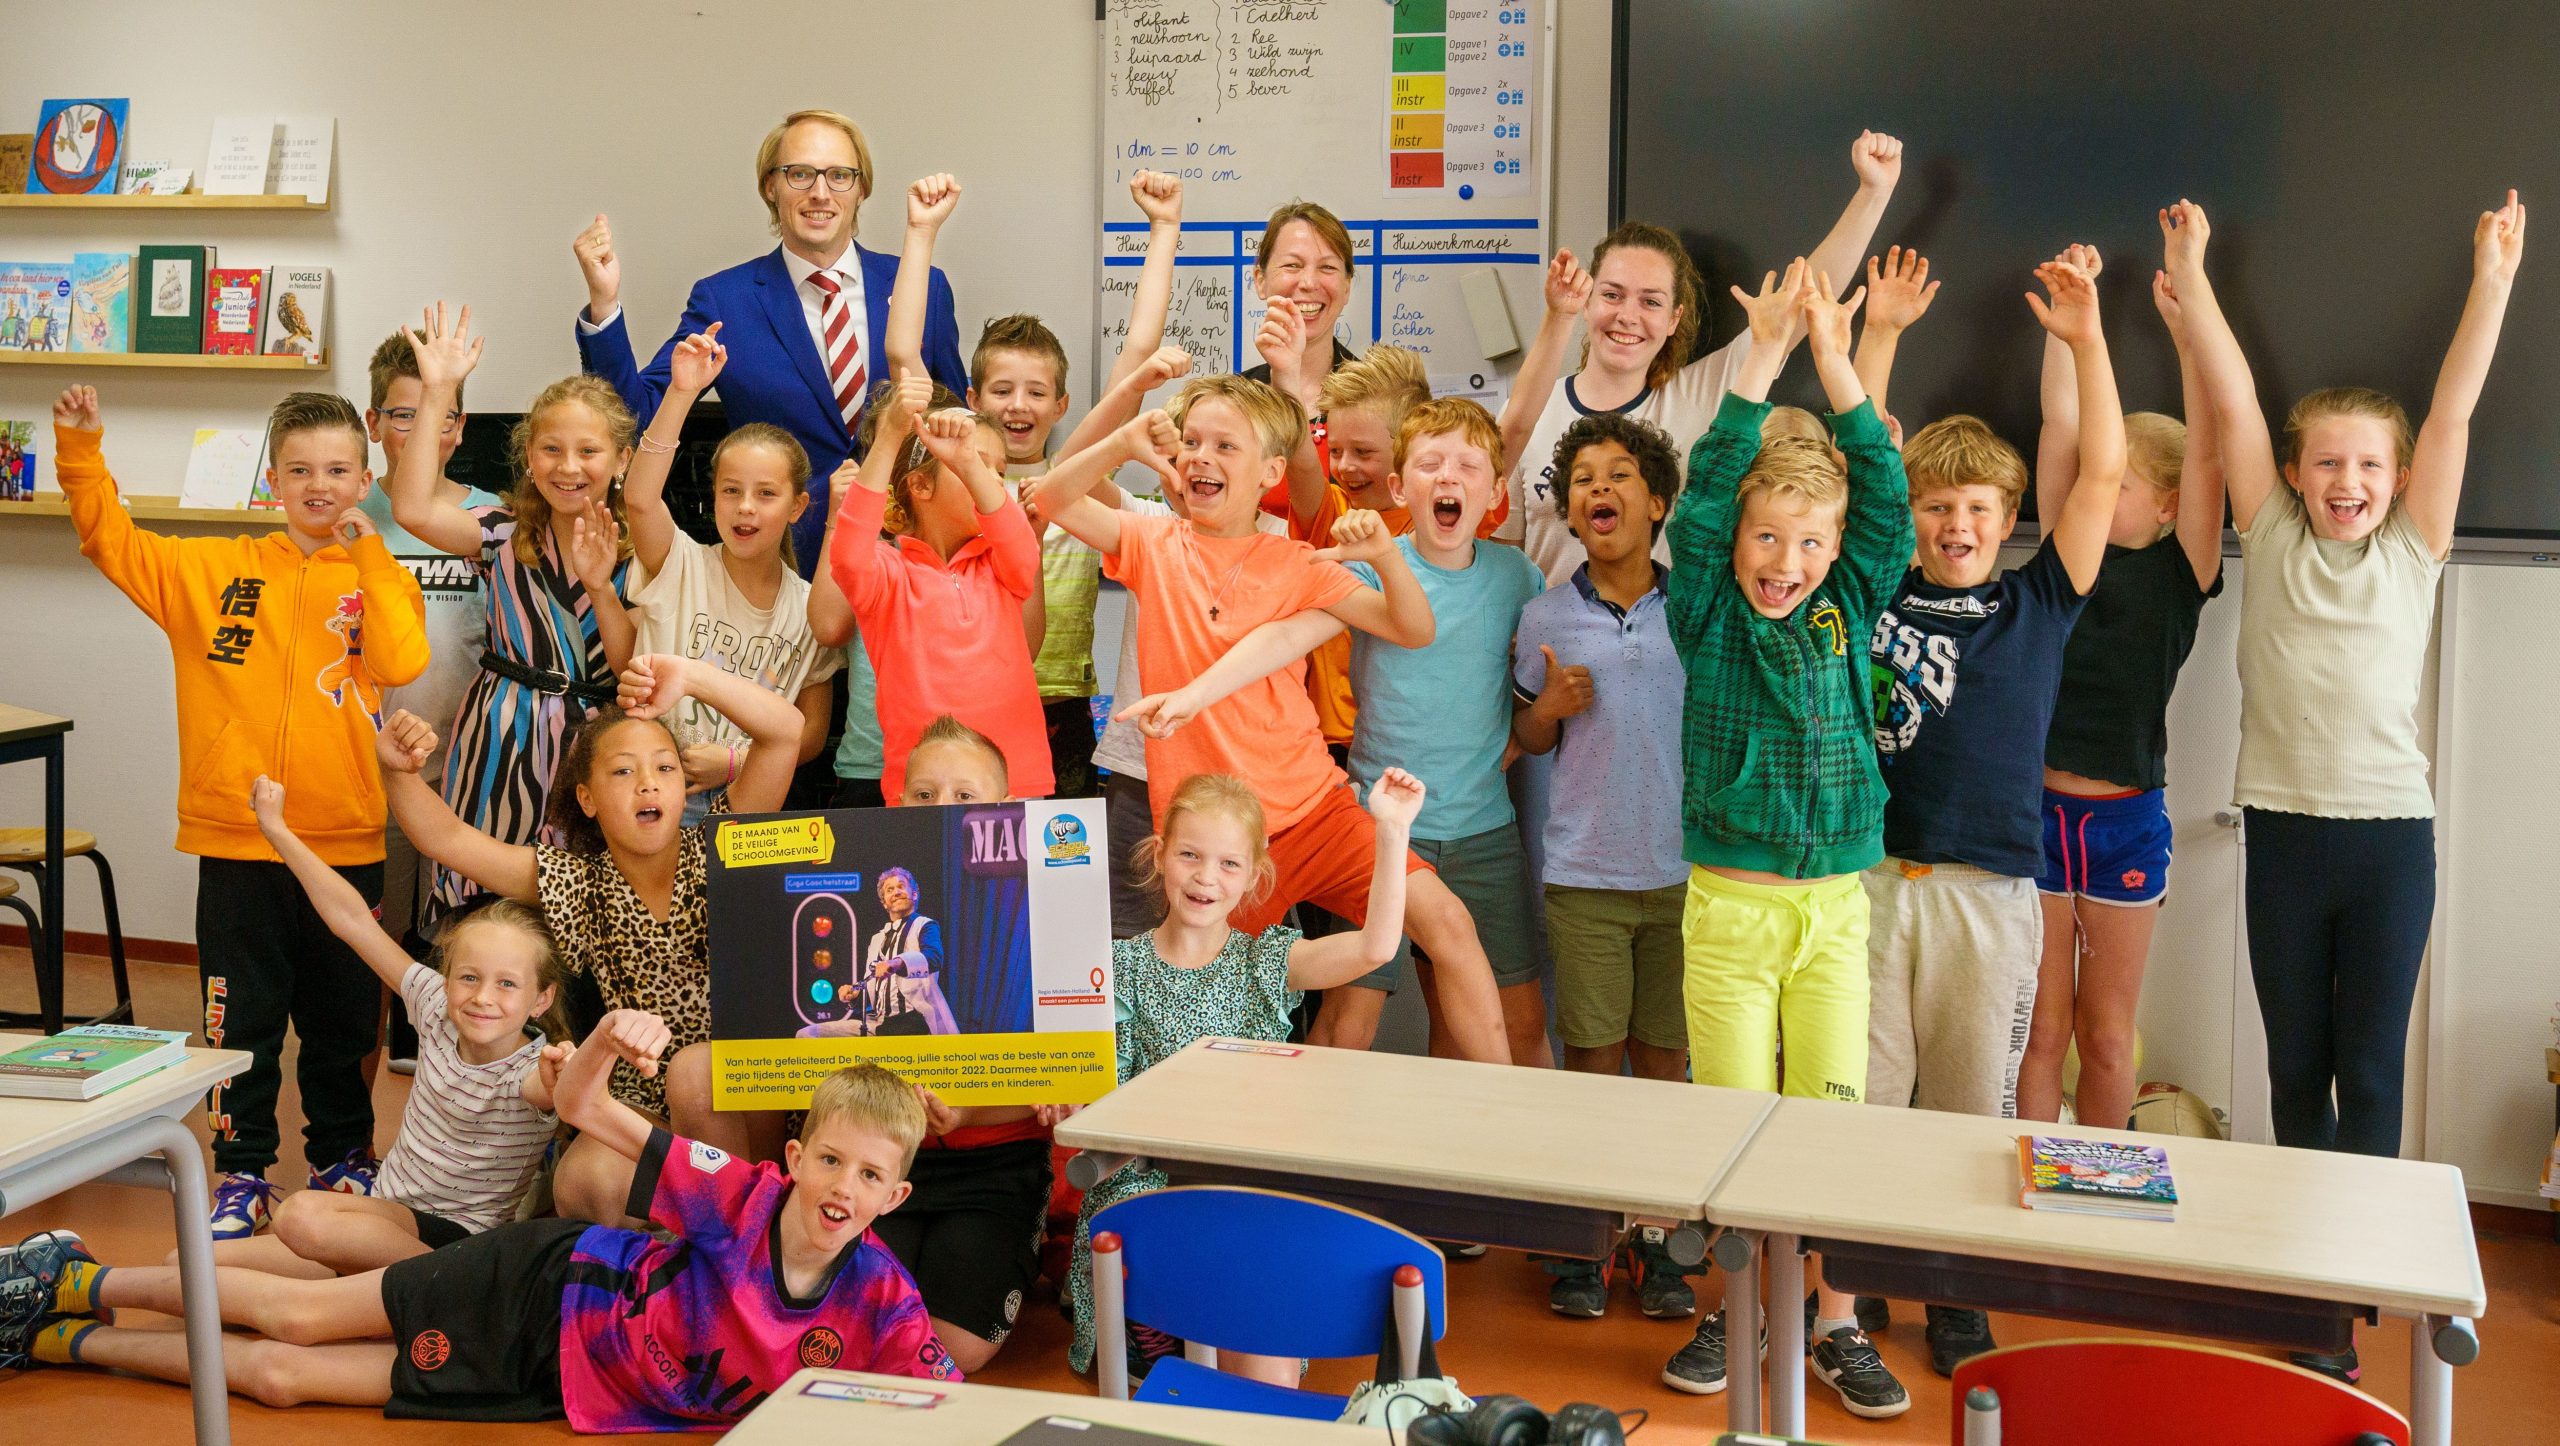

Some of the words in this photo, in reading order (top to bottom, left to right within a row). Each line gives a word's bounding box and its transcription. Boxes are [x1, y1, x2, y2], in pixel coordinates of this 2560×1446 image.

[1247, 7, 1319, 24] Edelhert
[1400, 3, 1410, 17] V
[1448, 10, 1481, 20] Opgave
[1482, 10, 1488, 18] 2
[1133, 12, 1190, 32] olifant
[1131, 29, 1210, 46] neushoorn
[1232, 33, 1241, 44] 2
[1251, 29, 1278, 43] Ree
[1498, 33, 1509, 41] 2x
[1400, 42, 1415, 56] IV
[1448, 40, 1481, 50] Opgave
[1482, 40, 1487, 48] 1
[1126, 48, 1206, 69] luipaard
[1230, 48, 1238, 61] 3
[1248, 44, 1281, 59] Wild
[1287, 43, 1324, 63] zwijn
[1448, 52, 1481, 63] Opgave
[1482, 52, 1487, 60] 2
[1125, 67, 1179, 82] leeuw
[1247, 59, 1314, 77] zeehond
[1228, 84, 1238, 98] 5
[1247, 78, 1291, 96] bever
[1397, 79, 1409, 91] III
[1498, 80, 1508, 88] 2x
[1125, 80, 1175, 105] buffel
[1396, 93, 1425, 106] instr
[1448, 87, 1481, 97] Opgave
[1482, 87, 1487, 95] 2
[1396, 118, 1404, 130] II
[1446, 123, 1478, 133] Opgave
[1479, 123, 1485, 132] 3
[1128, 139, 1157, 158] dm
[1186, 143, 1199, 155] 10
[1208, 143, 1237, 156] cm
[1394, 135, 1422, 147] instr
[1446, 162, 1478, 172] Opgave
[1479, 162, 1485, 171] 3
[1211, 169, 1242, 181] cm
[1394, 173, 1423, 185] instr
[1392, 232, 1512, 254] Huiswerkmapje
[289, 272, 322, 282] VOGELS
[225, 302, 246, 312] Junior
[1392, 303, 1425, 320] Lisa
[1392, 321, 1434, 336] Esther
[206, 577, 266, 666] 悟空
[686, 612, 802, 691] GROW
[732, 831, 743, 839] DE
[745, 828, 779, 838] MAAND
[782, 826, 800, 834] VAN
[732, 842, 743, 850] DE
[745, 839, 778, 849] VEILIGE
[732, 846, 819, 861] SCHOOLOMGEVING
[725, 1057, 744, 1067] Van
[746, 1057, 772, 1066] harte
[775, 1056, 836, 1068] gefeliciteerd
[838, 1055, 852, 1064] De
[854, 1054, 915, 1065] Rgenboog,
[917, 1053, 940, 1065] jullie
[943, 1051, 977, 1062] school
[979, 1052, 999, 1061] was
[1002, 1051, 1016, 1060] de
[1018, 1050, 1046, 1060] beste
[1049, 1052, 1068, 1060] van
[1071, 1051, 1096, 1059] onze
[725, 1072, 750, 1082] regio
[753, 1070, 786, 1081] tijdens
[788, 1070, 801, 1079] de
[961, 1065, 989, 1075] 2022.
[990, 1064, 1037, 1074] Daarmee
[1040, 1064, 1077, 1073] winnen
[1080, 1062, 1104, 1075] jullie
[726, 1085, 745, 1094] een
[747, 1083, 796, 1095] uitvoering
[798, 1084, 816, 1092] van
[929, 1080, 951, 1089] voor
[954, 1078, 989, 1089] ouders
[1007, 1077, 1055, 1088] kinderen.
[814, 1330, 839, 1349] PARIS
[644, 1333, 679, 1382] ACCOR
